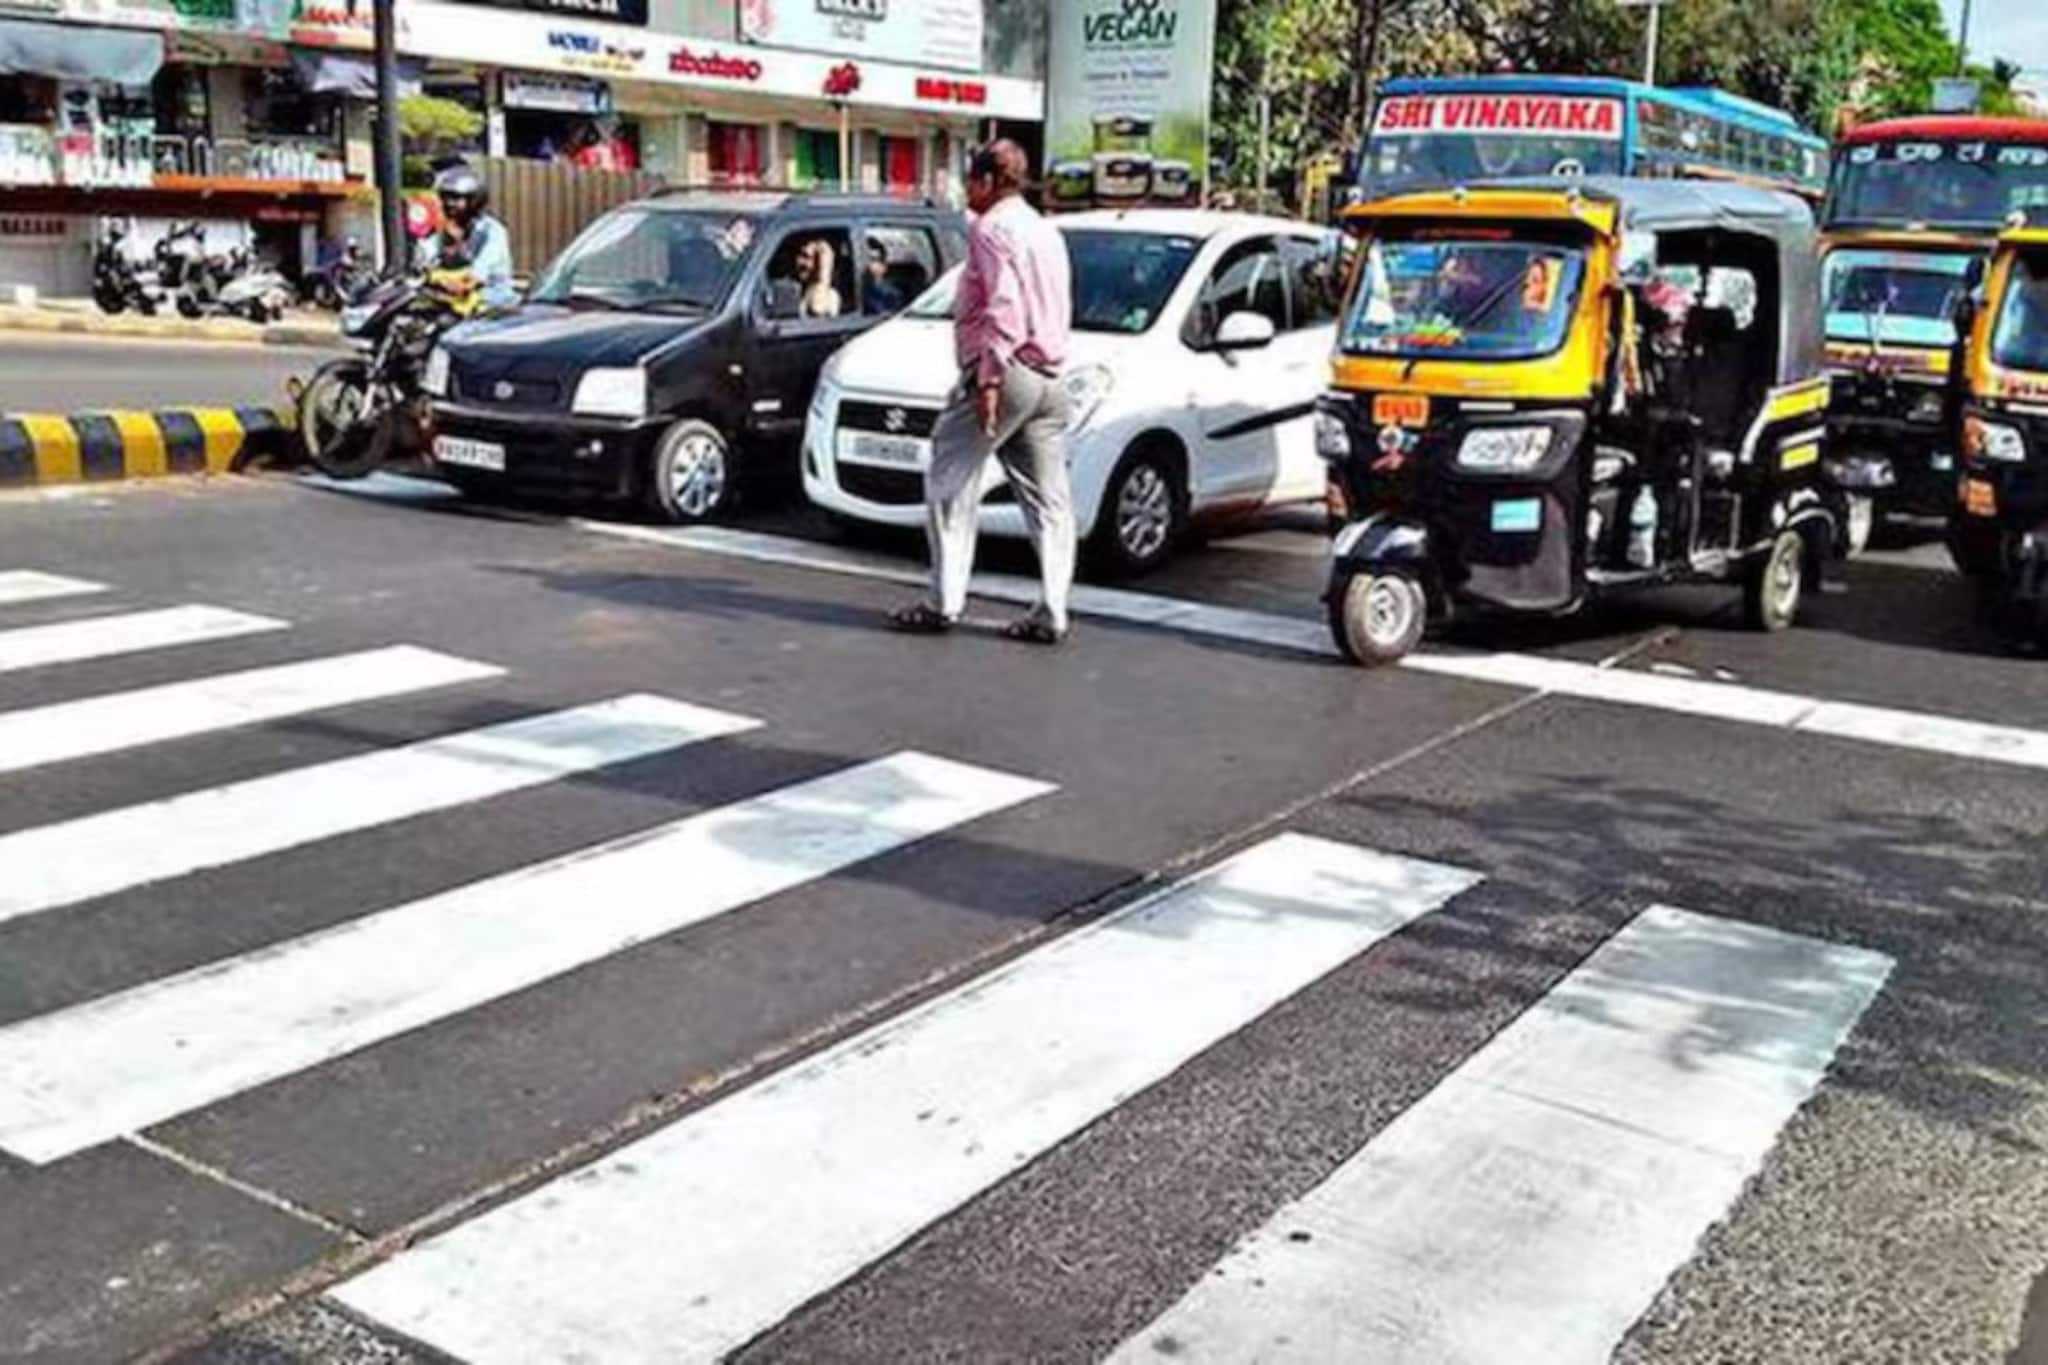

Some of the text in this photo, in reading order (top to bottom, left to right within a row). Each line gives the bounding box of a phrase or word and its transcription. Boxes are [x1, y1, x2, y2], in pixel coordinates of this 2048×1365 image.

[1083, 11, 1177, 42] VEGAN
[1379, 97, 1615, 133] SRI VINAYAKA
